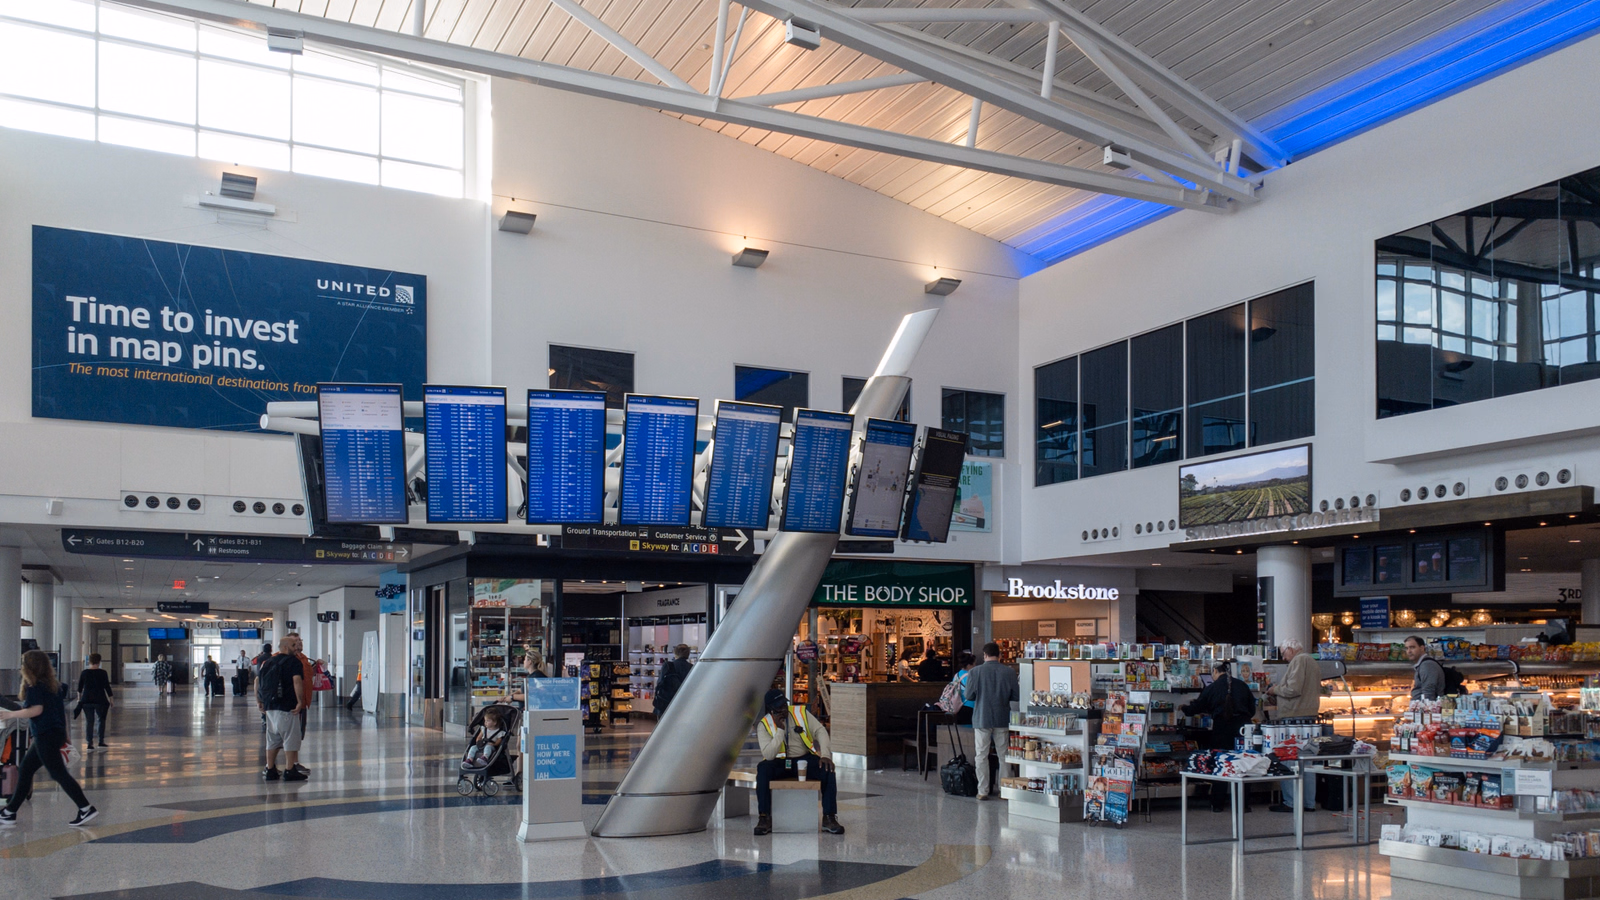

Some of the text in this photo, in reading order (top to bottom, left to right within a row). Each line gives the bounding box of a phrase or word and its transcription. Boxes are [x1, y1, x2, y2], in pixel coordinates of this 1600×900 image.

[316, 278, 391, 298] UNITED
[382, 306, 405, 314] MEMBER
[66, 295, 299, 345] Time to invest
[67, 326, 266, 371] in map pins.
[69, 362, 93, 376] The
[97, 365, 129, 379] most
[134, 367, 214, 386] international
[217, 372, 290, 392] destinations
[566, 526, 637, 538] Ground Transportation
[655, 531, 707, 541] Customer Service
[96, 537, 145, 546] Gates B12-B20
[218, 538, 262, 546] Gates B21-B31
[341, 542, 366, 550] Baggage
[218, 547, 250, 555] Restrooms
[641, 542, 670, 551] Skyway
[670, 543, 680, 551] to:
[326, 550, 351, 559] Skyway
[1007, 577, 1119, 601] Brookstone
[822, 584, 968, 604] THE BODY SHOP.
[1557, 588, 1582, 603] 3RD
[656, 597, 680, 608] FRAGRANCE
[195, 620, 239, 629] Gates
[536, 742, 560, 751] TELL US
[536, 758, 557, 766] DOING
[536, 771, 550, 780] IAH
